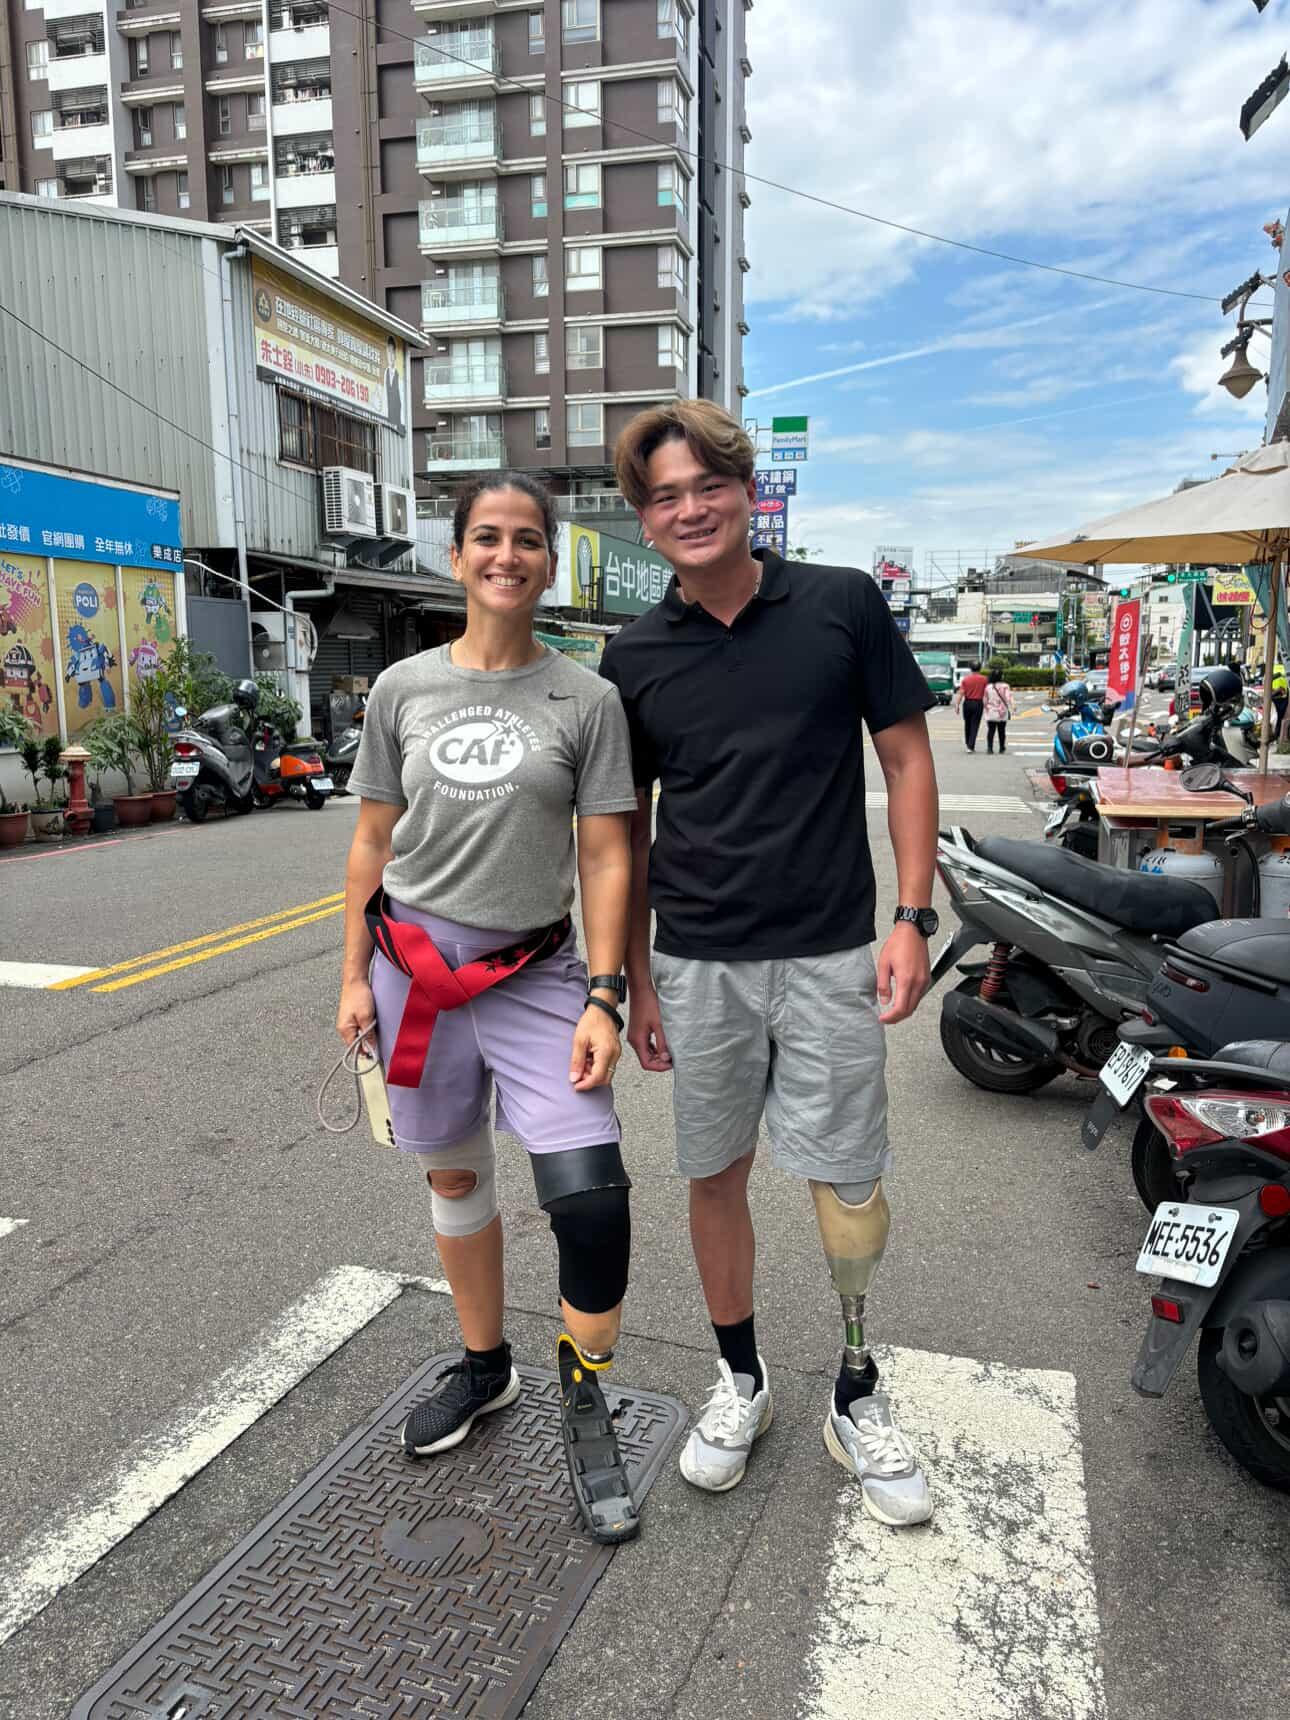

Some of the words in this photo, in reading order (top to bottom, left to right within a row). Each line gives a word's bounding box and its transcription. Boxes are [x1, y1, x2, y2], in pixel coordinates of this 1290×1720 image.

[41, 530, 85, 550] 官網團購
[94, 537, 134, 556] 全年無休
[1, 560, 24, 580] LET'S
[23, 587, 41, 606] FUN
[75, 595, 98, 608] POLI
[494, 706, 542, 753] ATHLETES
[437, 737, 513, 765] CAF
